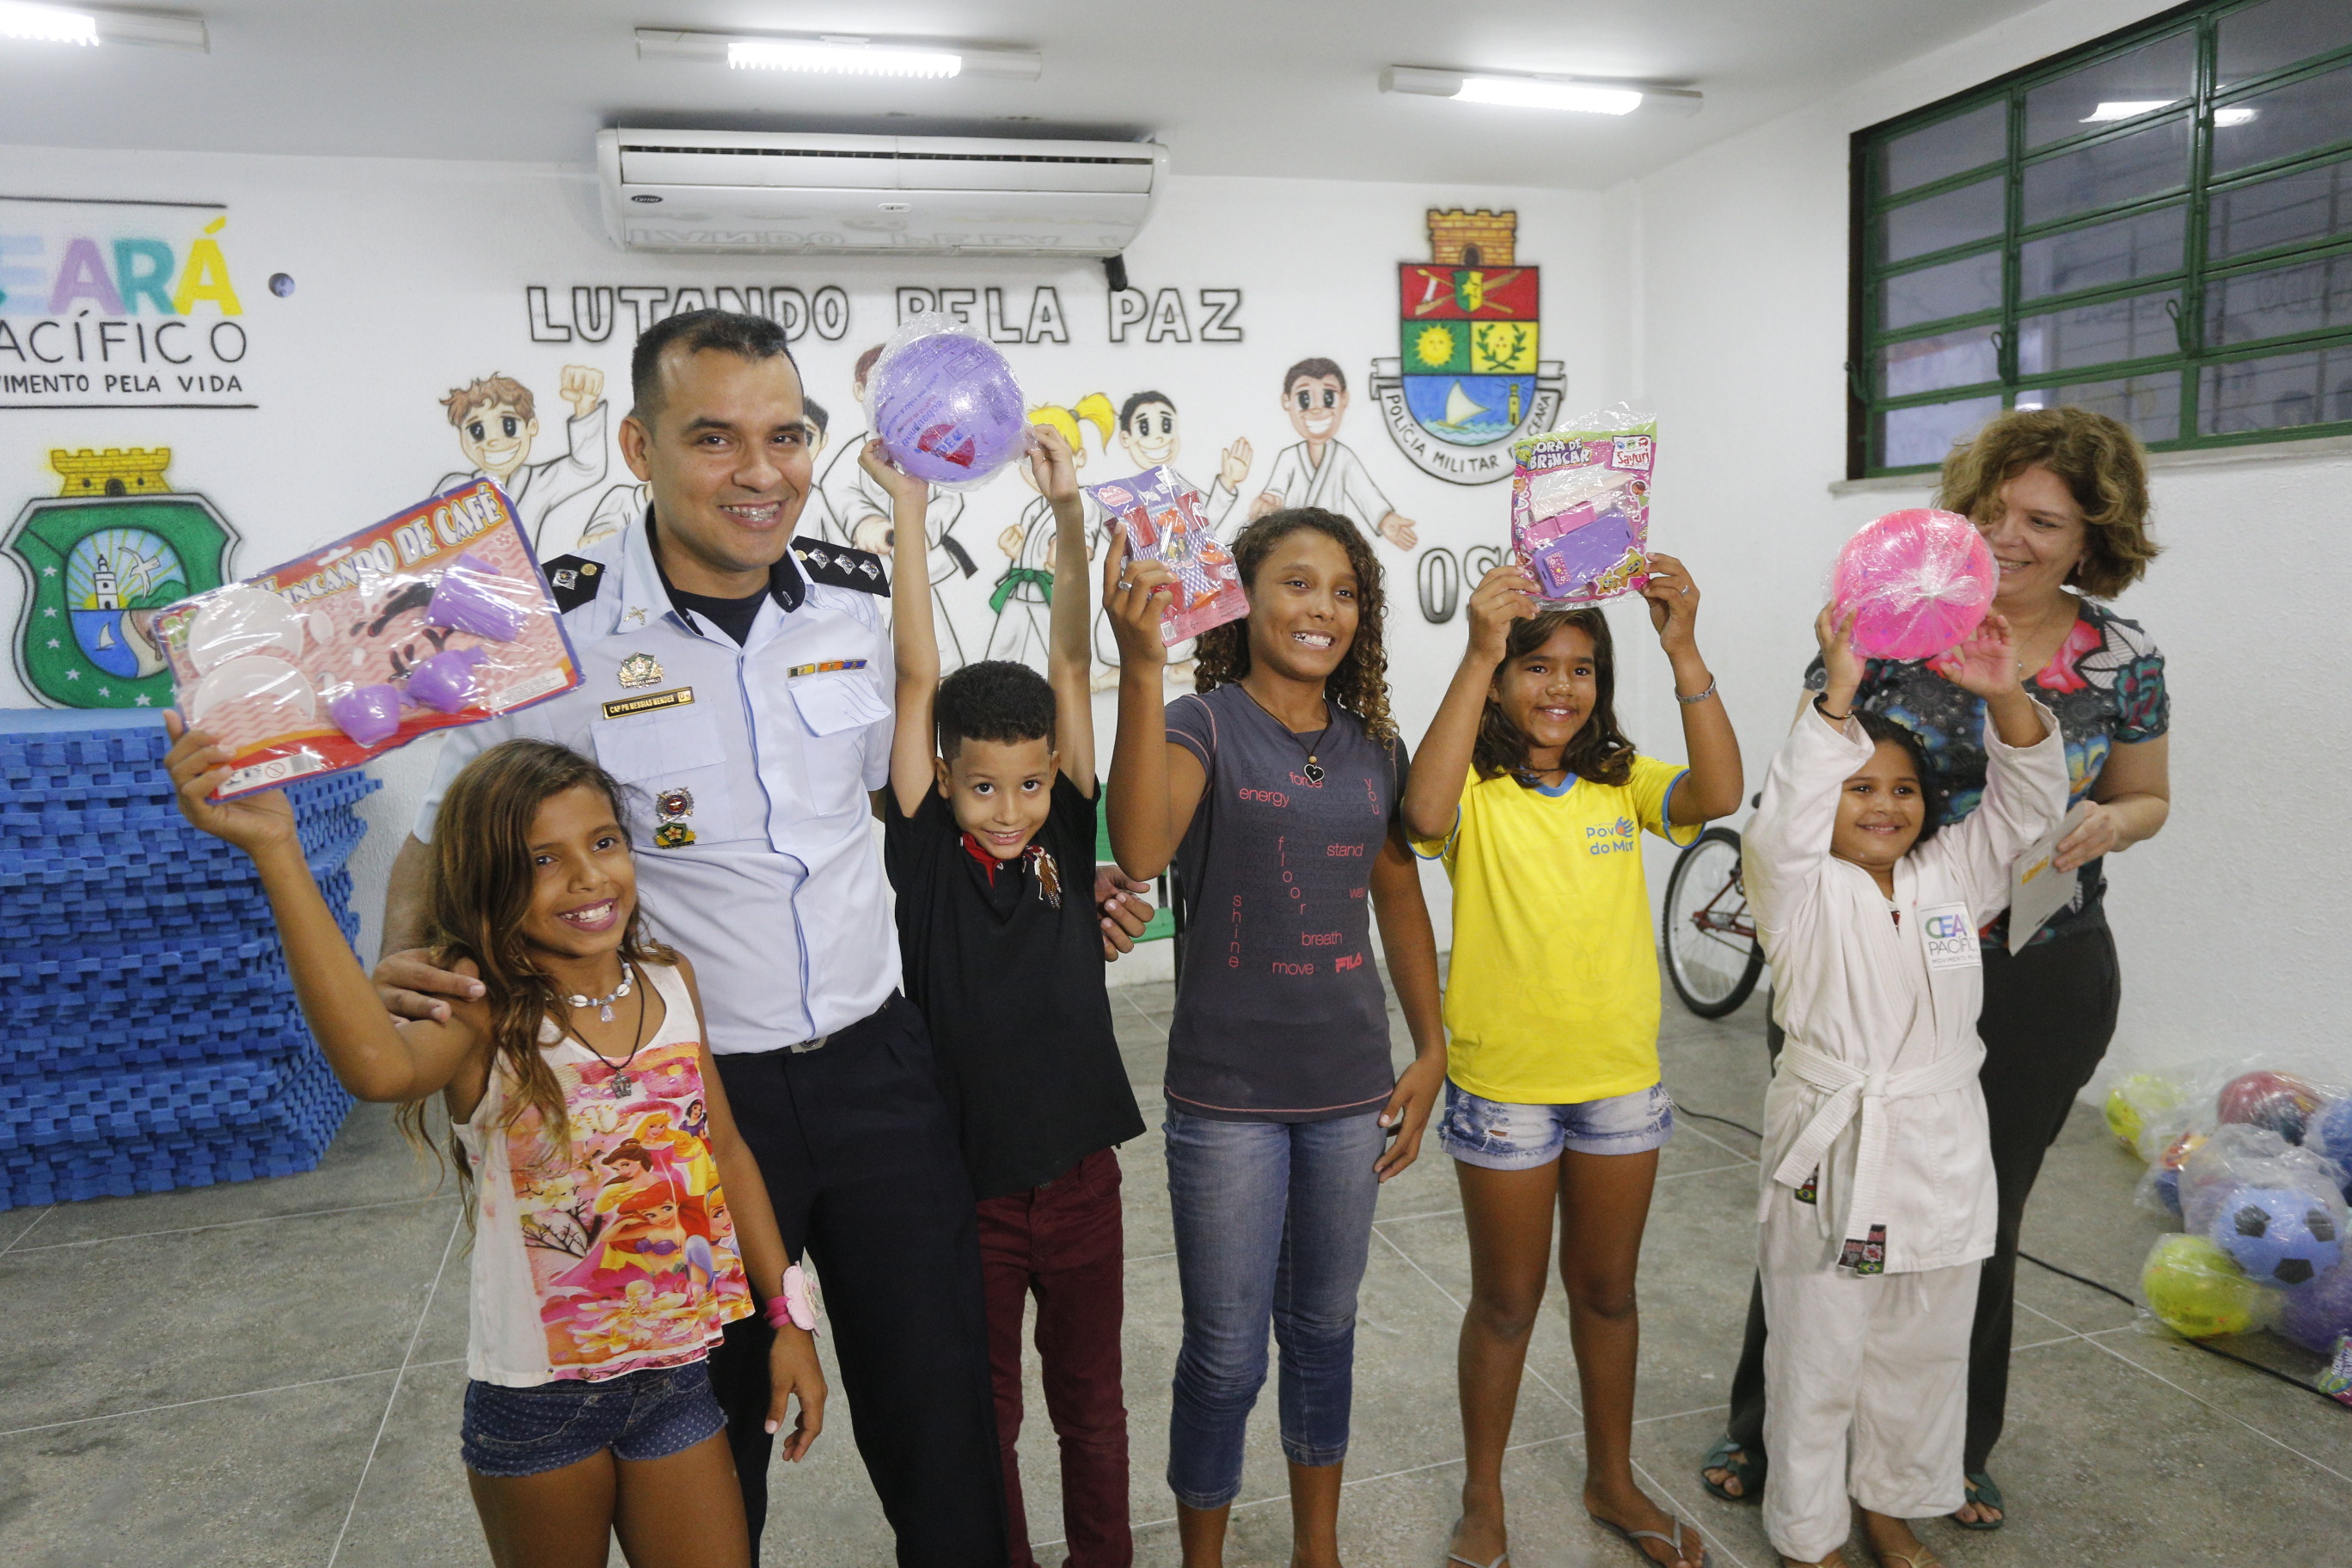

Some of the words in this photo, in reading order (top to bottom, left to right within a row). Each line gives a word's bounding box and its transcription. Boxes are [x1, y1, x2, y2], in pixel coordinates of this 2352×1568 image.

[0, 215, 244, 315] EARÁ
[896, 285, 1070, 344] PELA
[1107, 286, 1243, 344] PAZ
[0, 374, 89, 394] IMENTO
[104, 375, 162, 393] PELA
[177, 375, 243, 393] VIDA
[1386, 395, 1424, 457] POLÍCIA
[1433, 451, 1499, 473] MILITAR
[1533, 439, 1565, 454] ORA
[1569, 437, 1583, 451] DE
[256, 538, 396, 604] INCANDO
[394, 516, 439, 567] DE
[434, 483, 504, 547] CAFÉ
[1417, 545, 1518, 625] OS
[1239, 787, 1289, 808] energy
[1326, 842, 1364, 857] stand
[1589, 841, 1610, 855] do
[1302, 930, 1343, 946] breath
[1271, 961, 1314, 976] move
[1334, 951, 1363, 973] FILA
